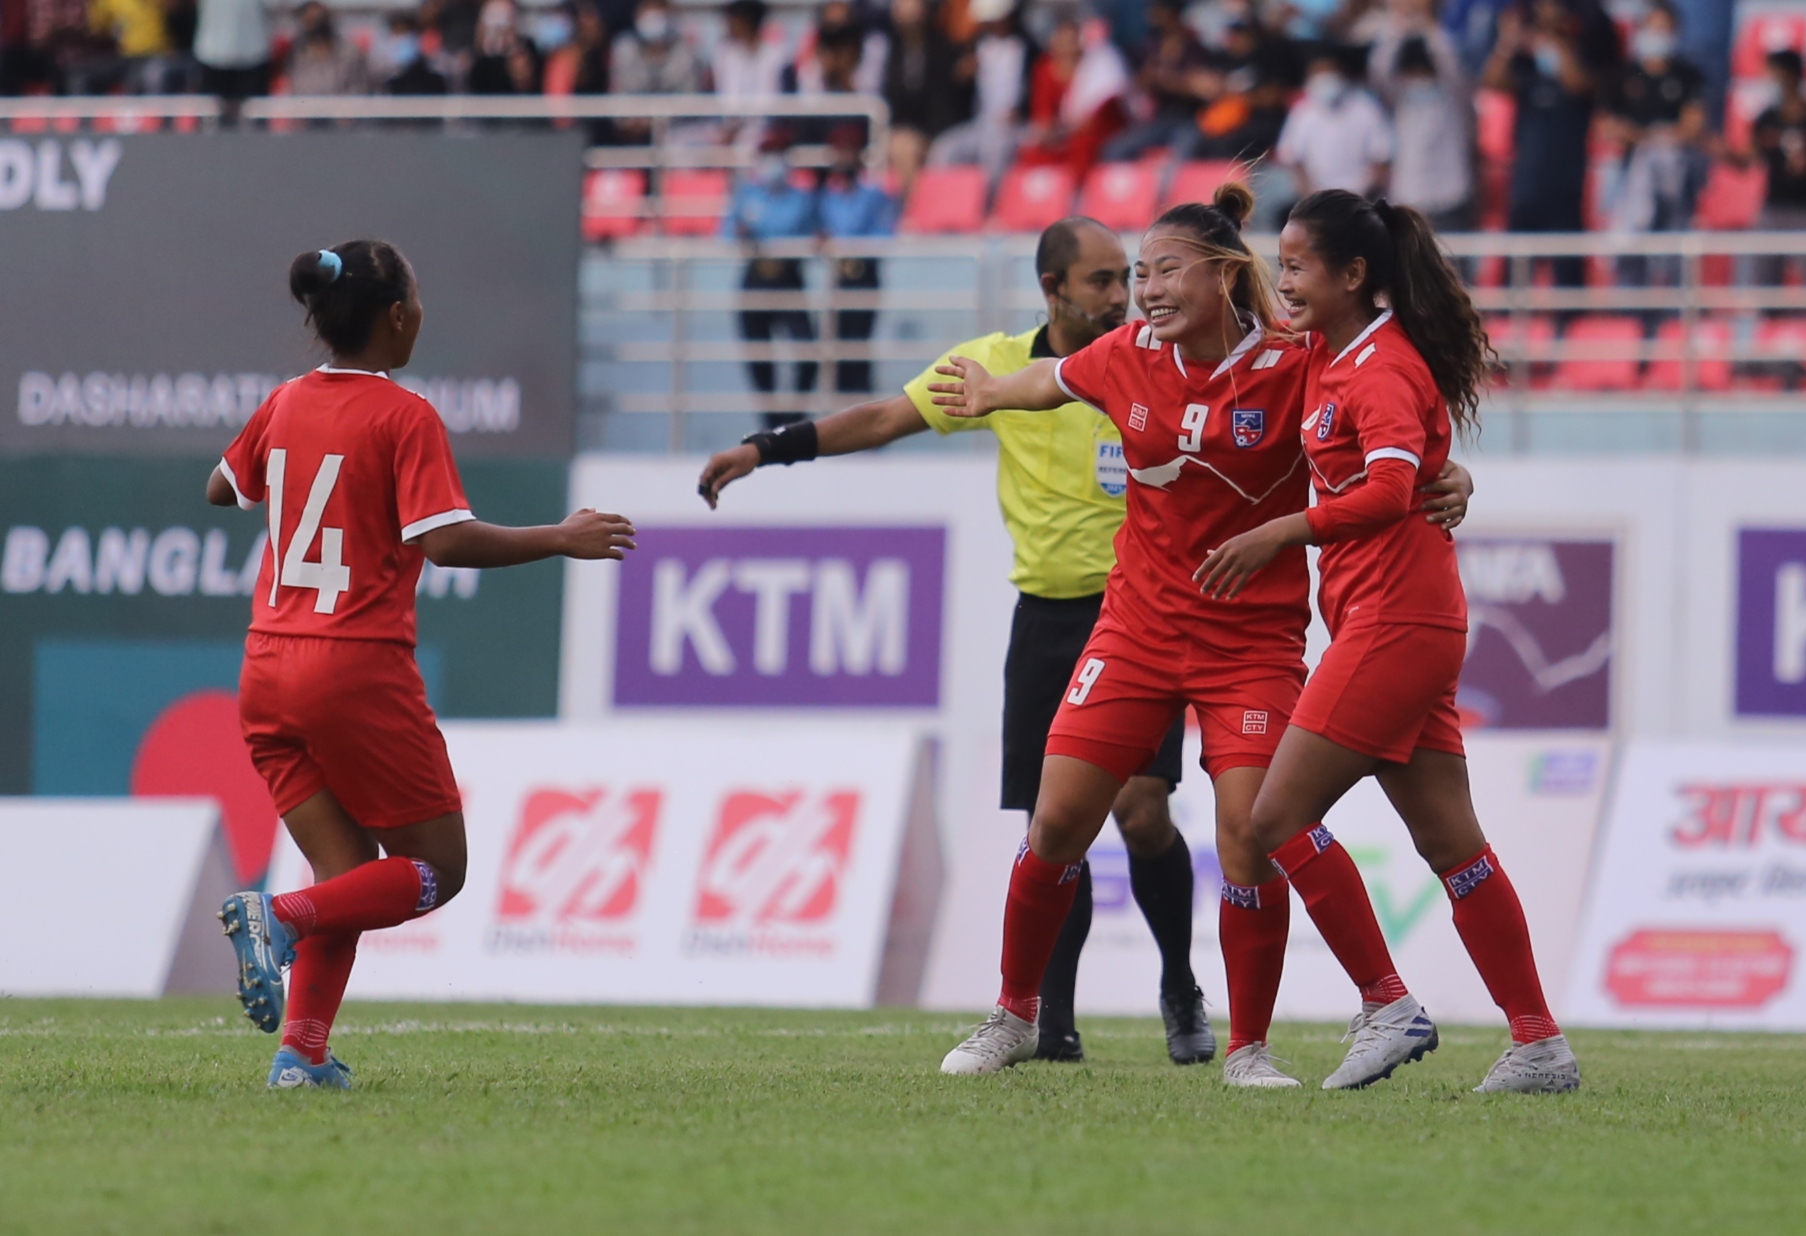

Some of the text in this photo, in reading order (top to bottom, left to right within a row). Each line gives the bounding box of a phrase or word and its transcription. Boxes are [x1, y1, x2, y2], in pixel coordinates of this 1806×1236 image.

[1100, 445, 1124, 458] FIF
[1178, 403, 1209, 452] 9
[265, 448, 350, 614] 14
[650, 556, 911, 677] KTM
[1067, 658, 1105, 706] 9
[1451, 861, 1485, 886] KTM
[1525, 1072, 1566, 1080] NEMESIS
